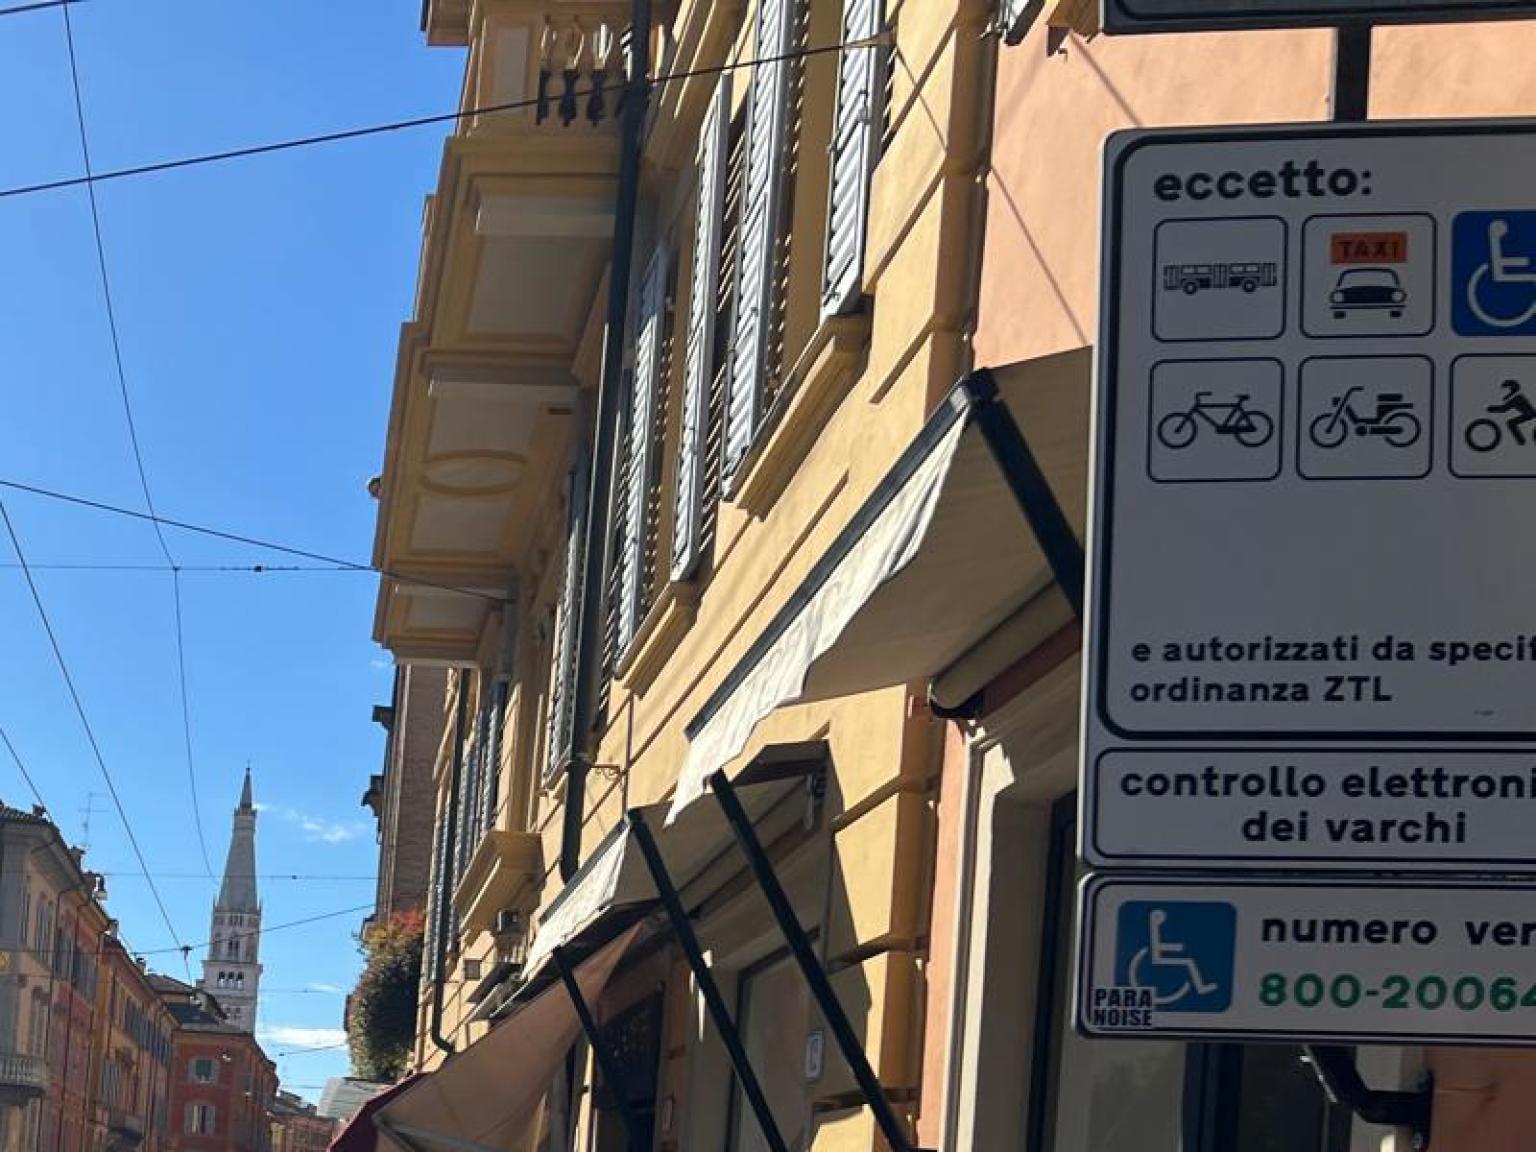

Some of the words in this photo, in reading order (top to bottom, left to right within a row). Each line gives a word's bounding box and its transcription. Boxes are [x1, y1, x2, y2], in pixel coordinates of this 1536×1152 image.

[1153, 159, 1372, 202] eccetto:
[1335, 240, 1400, 259] TAXI
[1131, 642, 1151, 663] e
[1162, 634, 1359, 662] autorizzati
[1371, 634, 1416, 662] da
[1130, 675, 1310, 702] ordinanza
[1323, 675, 1393, 702] ZTL
[1120, 765, 1327, 798] controllo
[1241, 809, 1309, 843] dei
[1324, 811, 1466, 844] varchi
[1261, 917, 1438, 946] numero
[1464, 921, 1536, 947] ver
[1094, 988, 1152, 1008] PARA
[1093, 1009, 1153, 1026] NOISE
